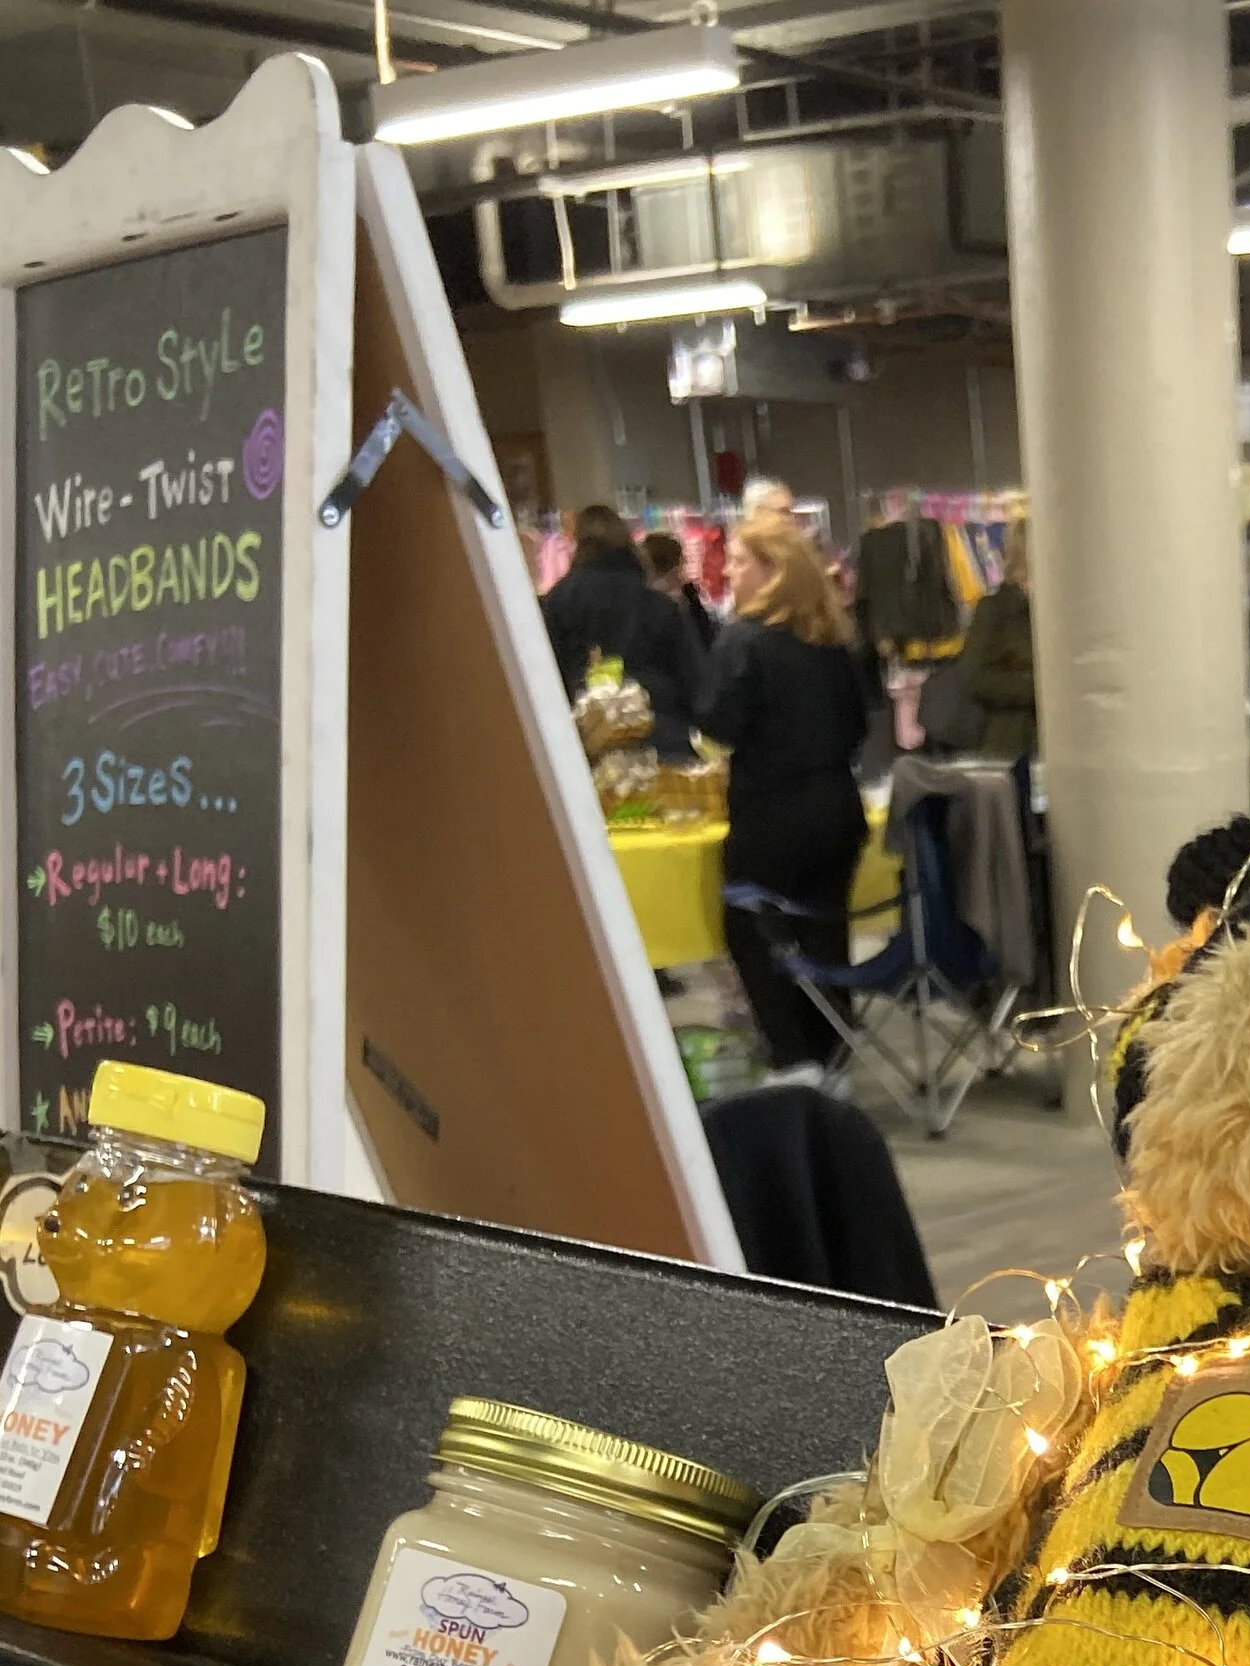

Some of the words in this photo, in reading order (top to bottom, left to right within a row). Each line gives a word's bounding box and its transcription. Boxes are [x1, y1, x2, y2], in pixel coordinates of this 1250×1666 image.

[36, 530, 262, 639] HEADBANDS
[60, 756, 86, 826] 3
[45, 841, 151, 907] Regular
[97, 905, 139, 952] $10
[146, 918, 185, 949] each
[0, 1410, 71, 1446] ONEY
[438, 1618, 486, 1644] SPUN
